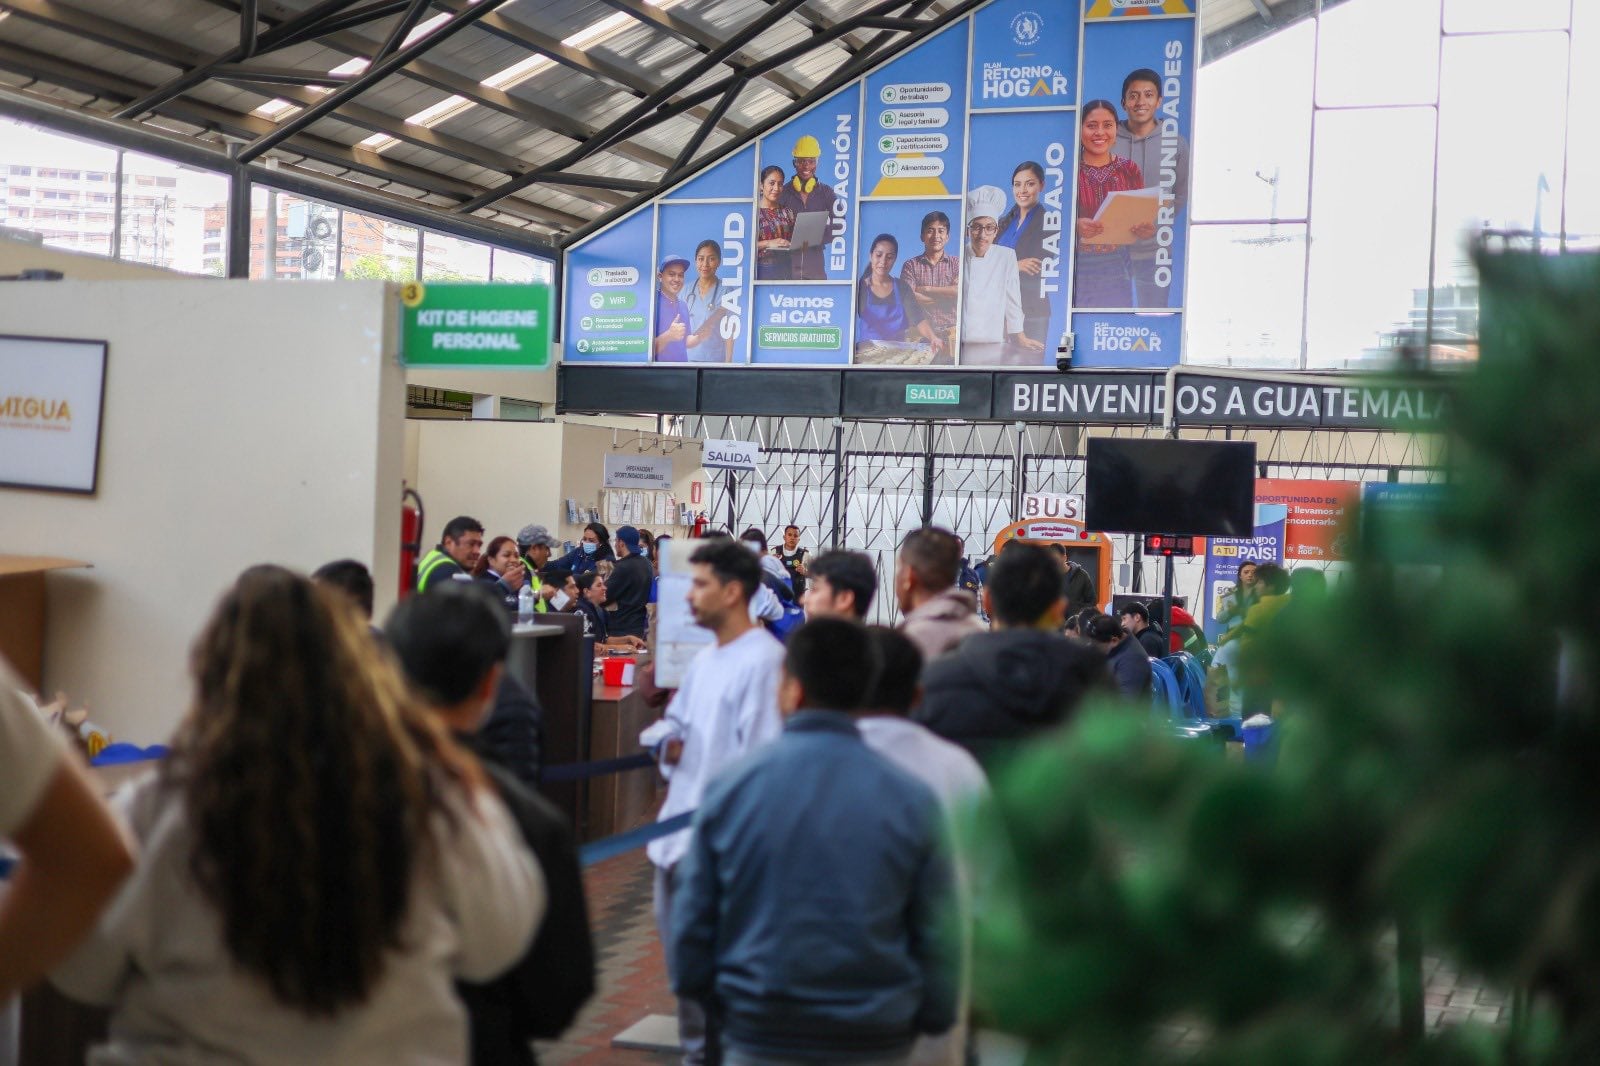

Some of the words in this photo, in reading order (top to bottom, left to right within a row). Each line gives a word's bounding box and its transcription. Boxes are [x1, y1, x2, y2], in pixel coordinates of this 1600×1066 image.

[984, 66, 1052, 80] RETORNO
[983, 76, 1068, 98] HOGAR
[1154, 40, 1182, 288] OPORTUNIDADES
[830, 114, 852, 271] EDUCACIÓN
[1040, 142, 1065, 299] TRABAJO
[720, 212, 744, 340] SALUD
[408, 286, 418, 300] 3
[610, 296, 626, 304] WiFi
[769, 294, 834, 308] Vamos
[417, 310, 443, 326] KIT
[445, 310, 469, 326] DE
[470, 310, 538, 327] HIGIENE
[770, 310, 786, 323] al
[789, 309, 831, 324] CAR
[764, 332, 798, 342] SERVICIOS
[799, 333, 836, 343] GRATUITOS
[1094, 327, 1149, 336] RETORNO
[432, 332, 520, 349] PERSONAL
[1093, 337, 1162, 351] HOGAR
[910, 388, 955, 399] SALIDA
[1013, 384, 1217, 414] BIENVENIDOS
[1224, 386, 1246, 416] A
[708, 451, 752, 463] SALIDA
[1255, 496, 1323, 504] OPORTUNIDAD
[1026, 497, 1077, 518] BUS
[1294, 506, 1333, 515] llevamos
[1238, 543, 1277, 560] PAÍS!
